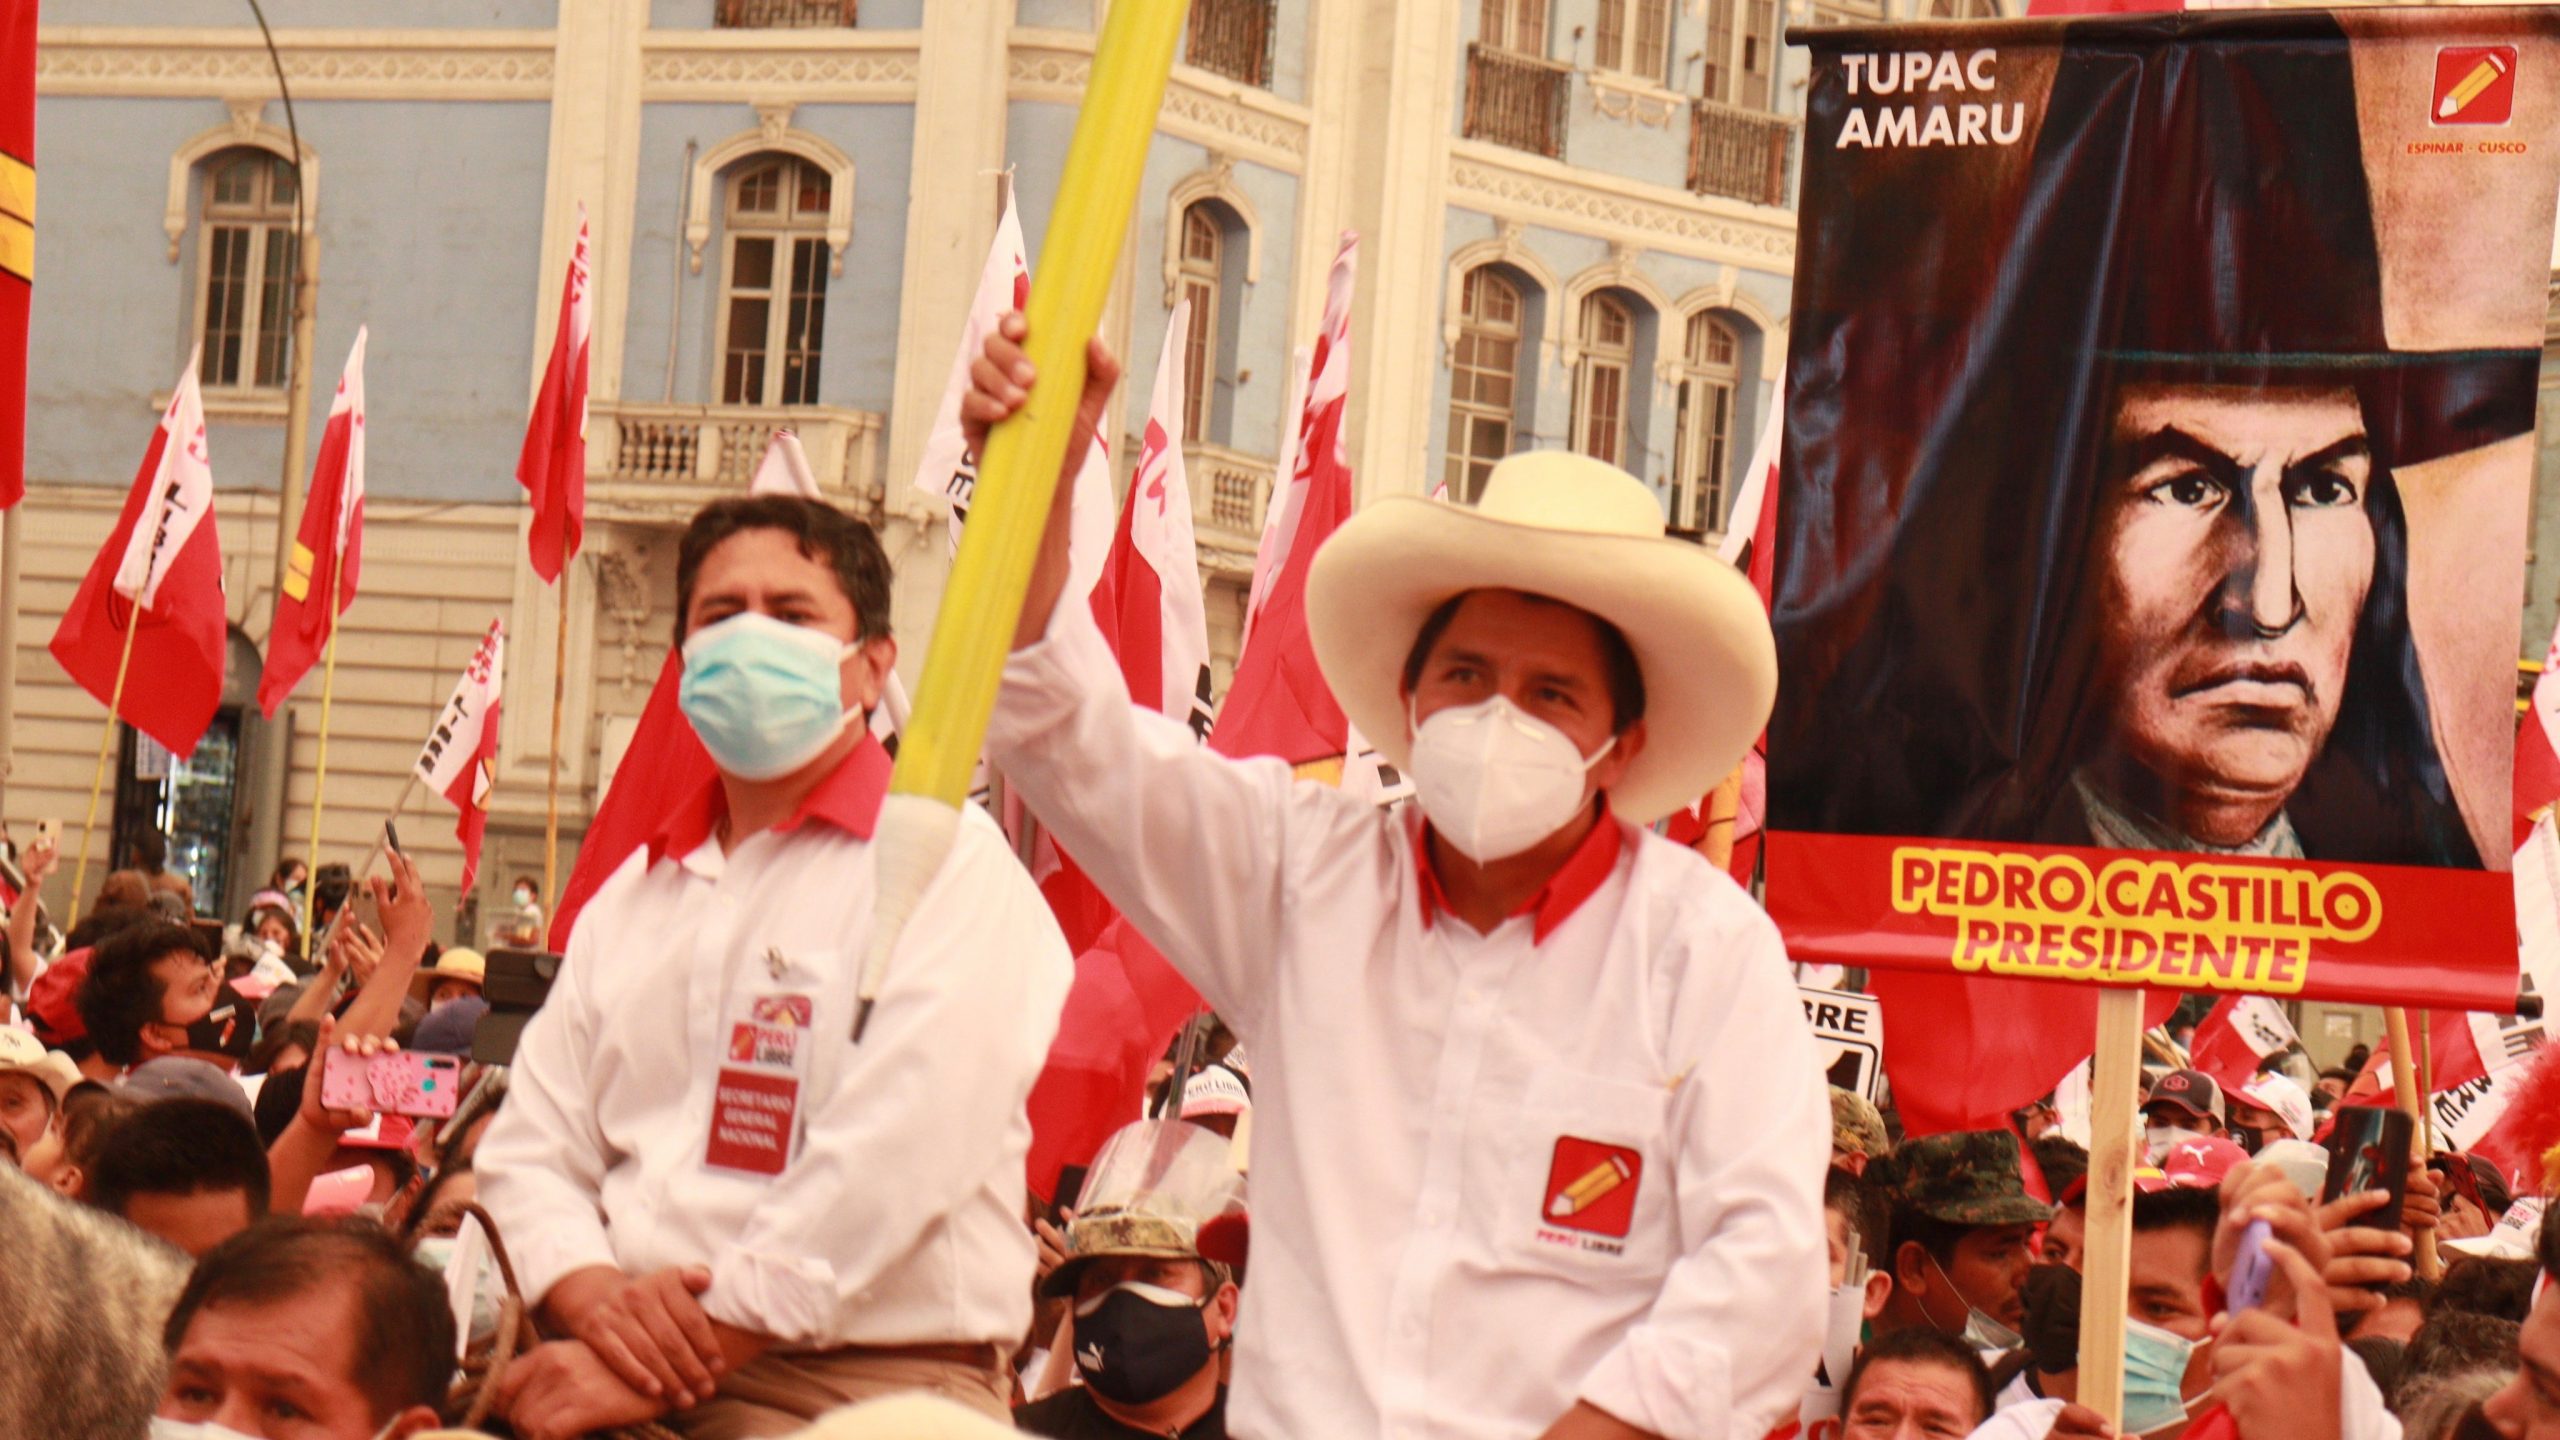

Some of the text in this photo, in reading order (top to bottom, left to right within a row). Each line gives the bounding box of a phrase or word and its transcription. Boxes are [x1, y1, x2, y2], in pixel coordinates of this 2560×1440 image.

[1841, 48, 1997, 95] TUPAC
[1835, 102, 2025, 149] AMARU
[2406, 142, 2464, 155] ESPINAR
[2478, 142, 2527, 154] CUSCO
[1902, 858, 2373, 932] PEDRO CASTILLO
[1962, 919, 2301, 983] PRESIDENTE
[718, 1086, 793, 1113] SECRETARIO
[718, 1125, 778, 1150] NACIONAL
[723, 1106, 779, 1132] GENERAL
